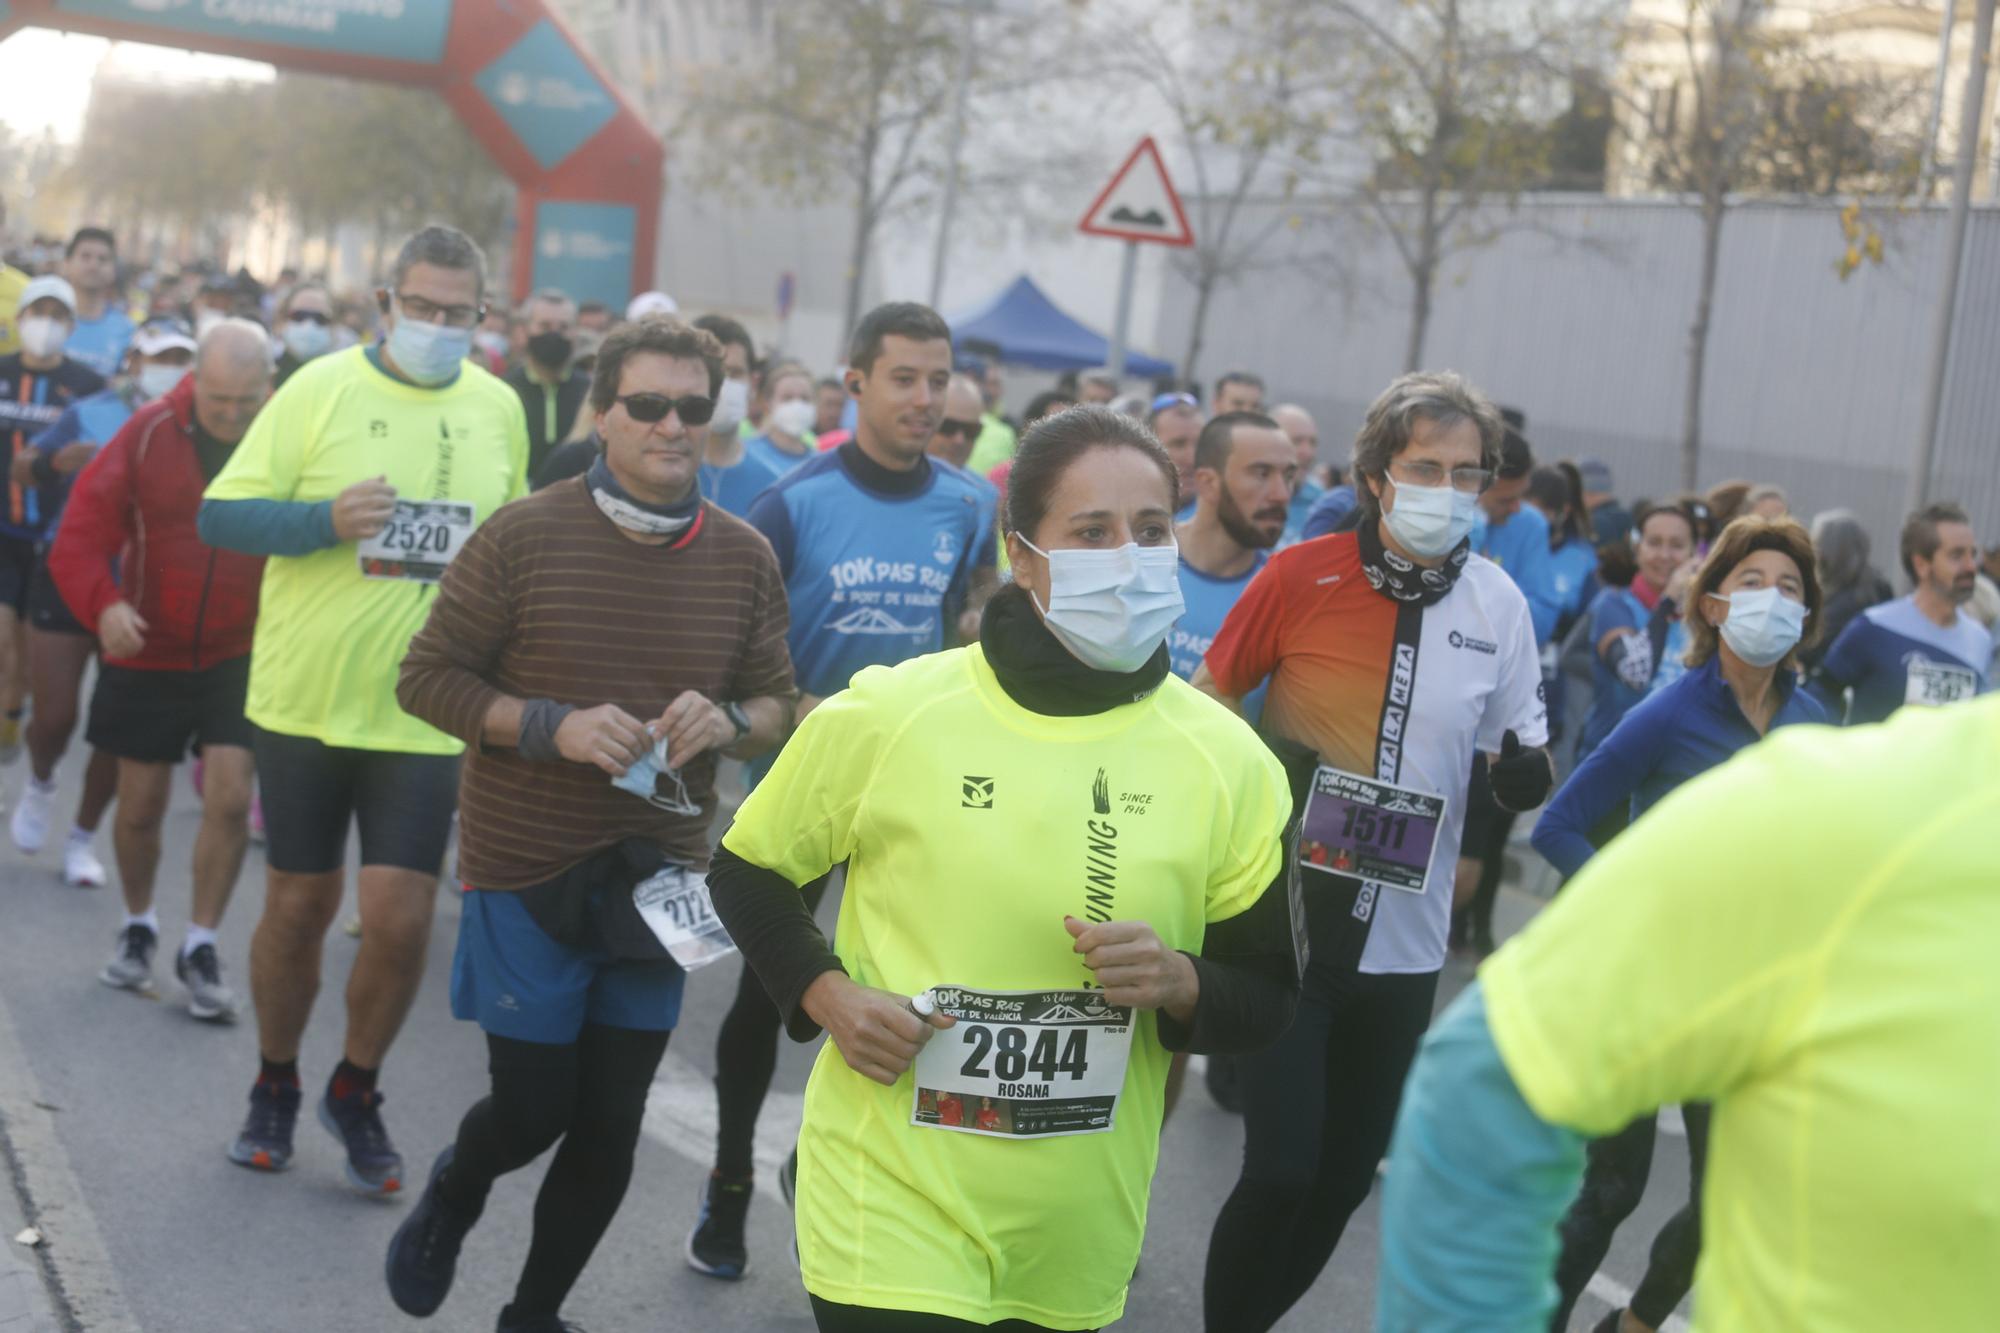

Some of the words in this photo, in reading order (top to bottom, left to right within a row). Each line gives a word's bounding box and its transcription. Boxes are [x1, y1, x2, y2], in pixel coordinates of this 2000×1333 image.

[382, 521, 450, 553] 2520
[830, 556, 874, 589] 10K
[875, 562, 916, 583] PAS
[1385, 711, 1401, 736] LA
[1393, 649, 1411, 702] META
[1120, 792, 1154, 804] SINCE
[1319, 774, 1342, 787] 10K
[1340, 779, 1360, 792] PAS
[1360, 784, 1380, 799] RAS
[1124, 804, 1146, 815] 1916
[1341, 804, 1409, 850] 1511
[1085, 819, 1118, 923] UNNING
[663, 887, 713, 930] 272
[963, 994, 993, 1008] PAS
[996, 999, 1025, 1012] RAS
[969, 1010, 981, 1020] DE
[984, 1011, 1022, 1021] VALÈNCIA
[960, 1025, 1088, 1082] 2844
[998, 1082, 1050, 1099] ROSANA
